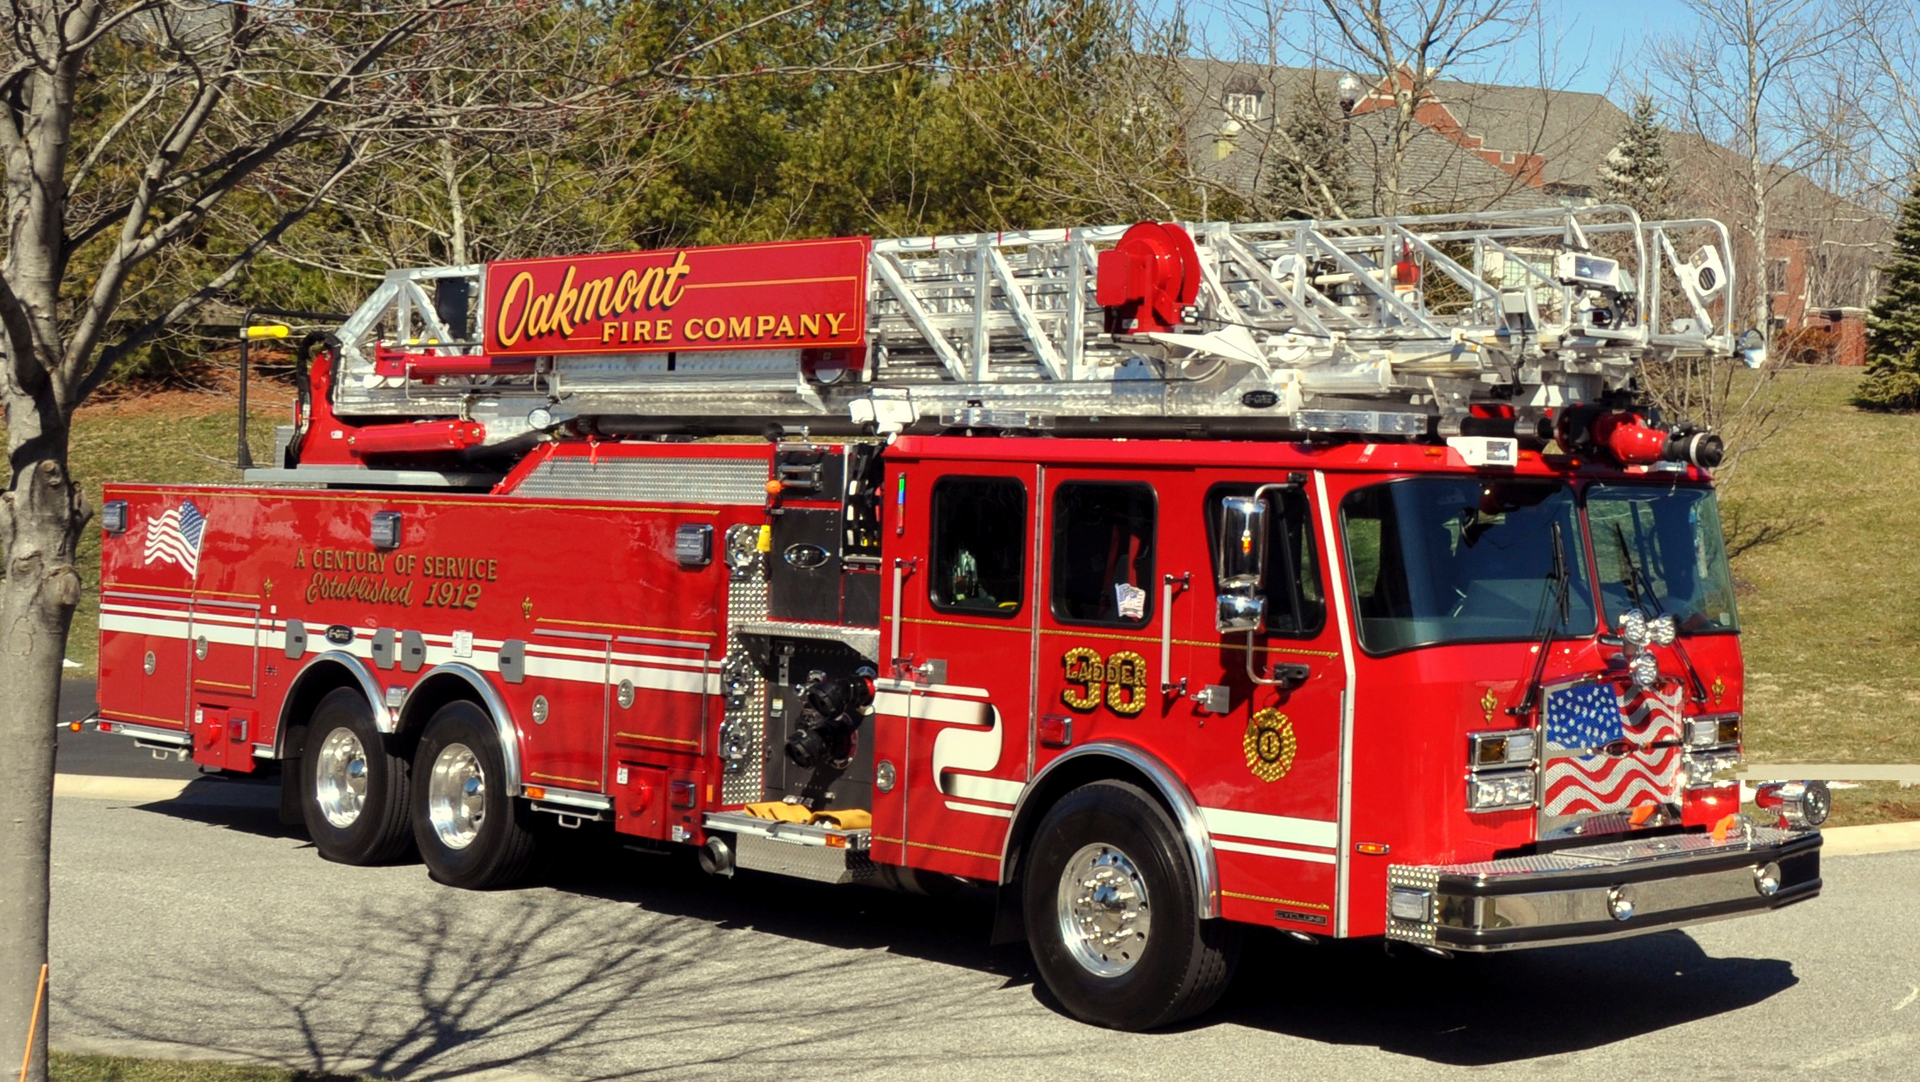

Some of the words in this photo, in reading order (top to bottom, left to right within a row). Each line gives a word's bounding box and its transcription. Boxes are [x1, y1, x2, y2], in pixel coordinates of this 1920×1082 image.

[498, 251, 690, 347] Oakmont
[601, 319, 673, 343] FIRE
[683, 312, 846, 340] COMPANY
[296, 549, 306, 567] A
[312, 549, 387, 574] CENTURY
[395, 554, 417, 576] OF
[424, 556, 498, 581] SERVICE
[306, 571, 414, 607] Established
[424, 582, 482, 610] 1912
[1064, 659, 1147, 686] LADDER
